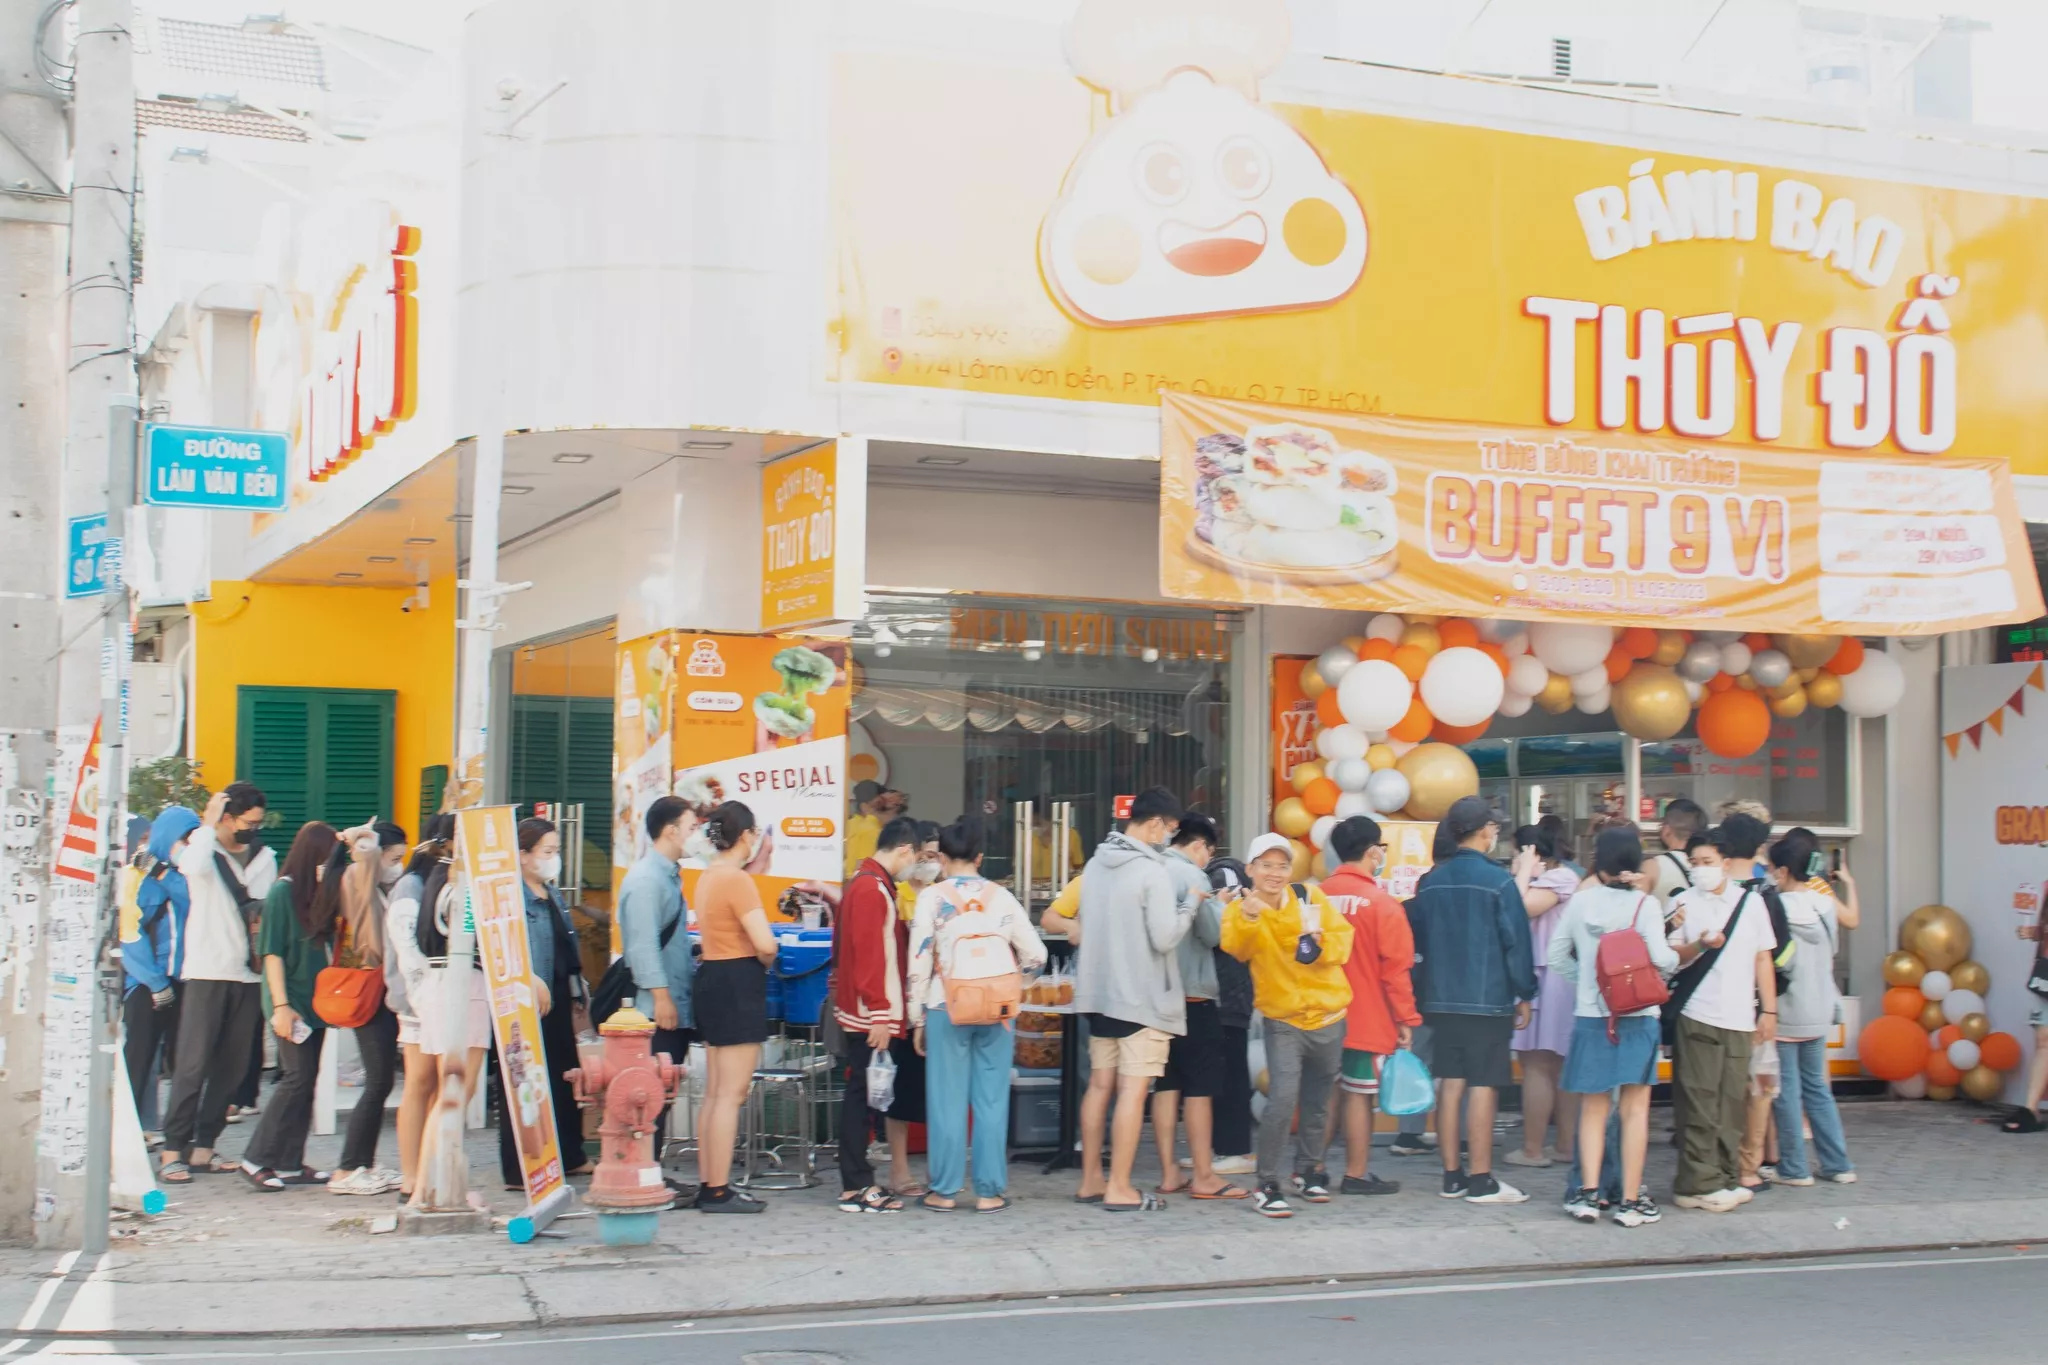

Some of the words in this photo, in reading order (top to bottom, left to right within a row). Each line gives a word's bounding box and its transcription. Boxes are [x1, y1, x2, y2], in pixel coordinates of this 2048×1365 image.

[1574, 158, 1759, 261] BÁNH
[1770, 179, 1904, 289] BAO
[959, 358, 1008, 381] Lâm
[1122, 371, 1138, 393] P.
[1818, 273, 1960, 453] ĐỖ
[183, 436, 262, 461] ĐƯỜNG
[157, 462, 196, 493] LÂM
[203, 466, 238, 496] VĂN
[1432, 476, 1658, 571] BUFFET
[1669, 494, 1710, 575] 9
[951, 607, 1027, 651] MEN
[738, 765, 836, 793] SPECIAL
[1995, 805, 2048, 845] GRA
